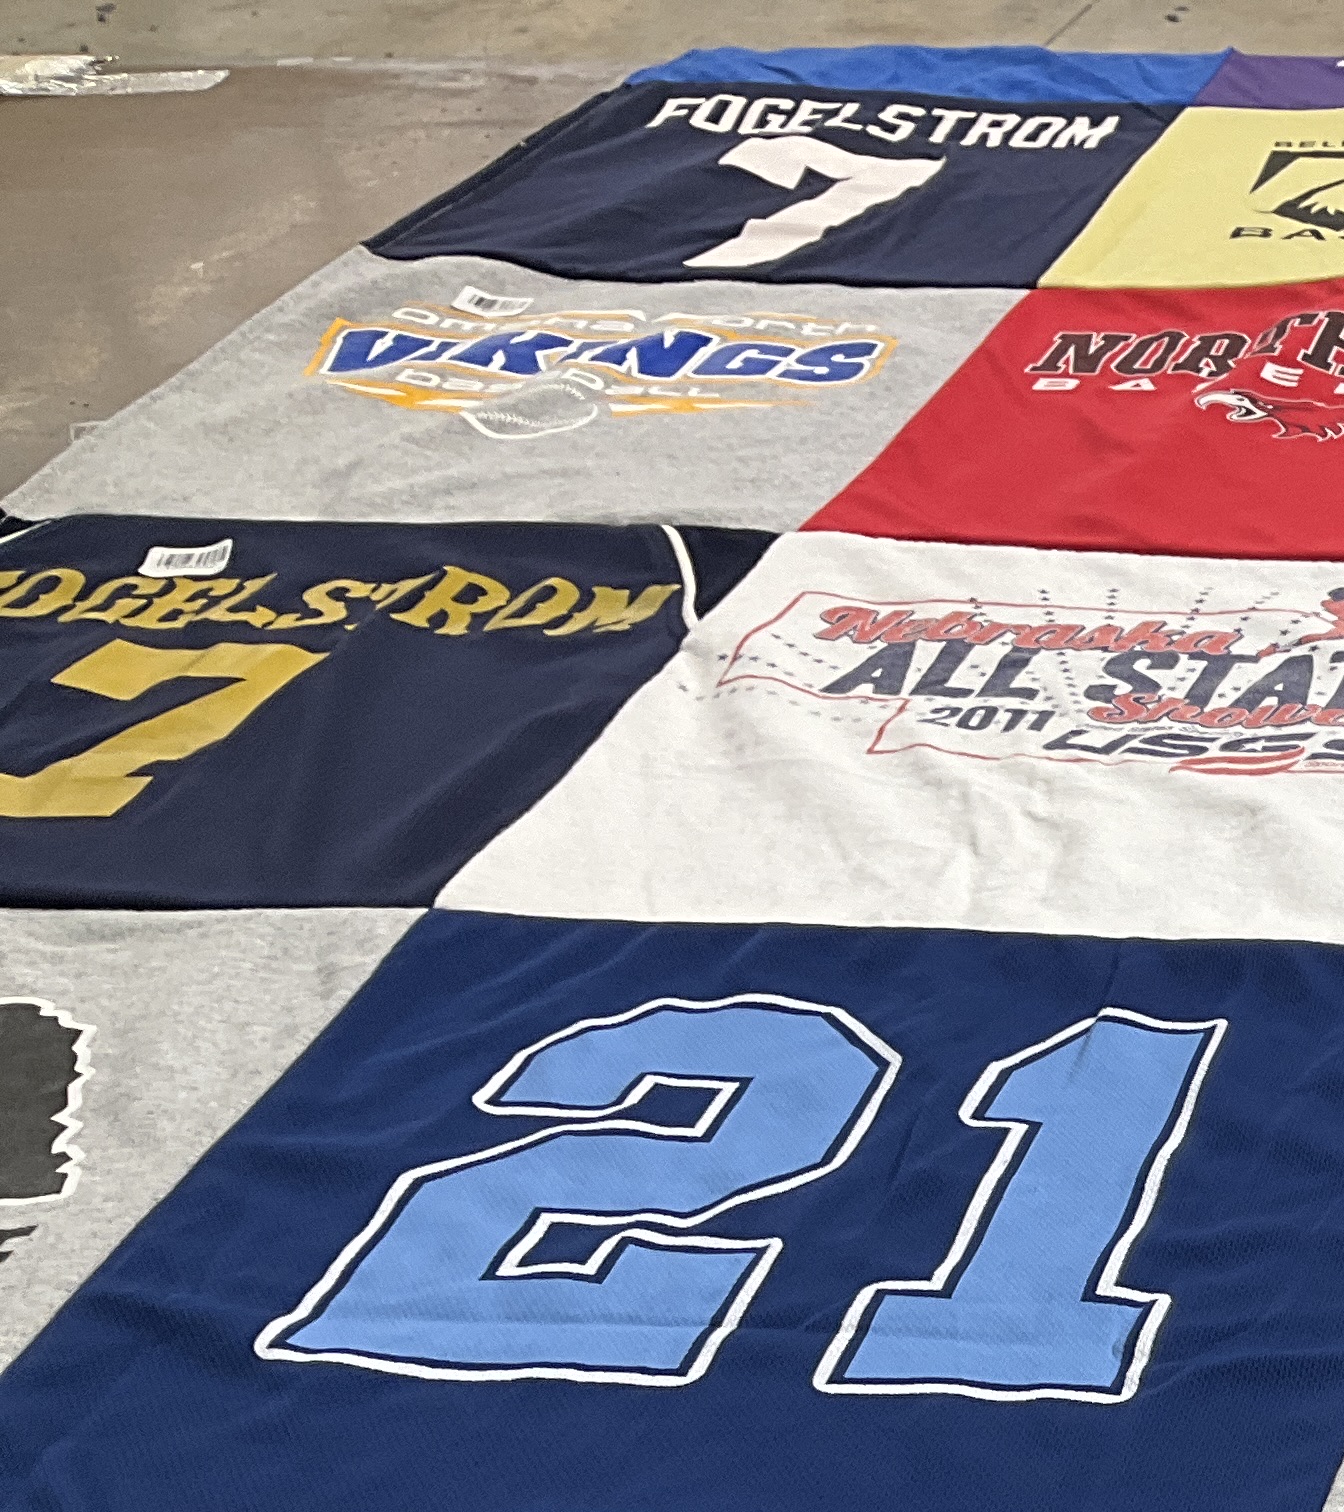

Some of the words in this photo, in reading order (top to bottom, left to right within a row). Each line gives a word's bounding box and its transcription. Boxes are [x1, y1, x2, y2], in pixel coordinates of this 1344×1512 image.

[646, 93, 1120, 151] FOGELSTROM
[683, 135, 947, 268] 7
[320, 328, 886, 386] VIKINGS
[818, 605, 1247, 656] Nebraska
[821, 637, 1050, 701] ALL
[0, 637, 331, 818] 7
[920, 705, 1056, 736] 2011
[255, 993, 1229, 1403] 21
